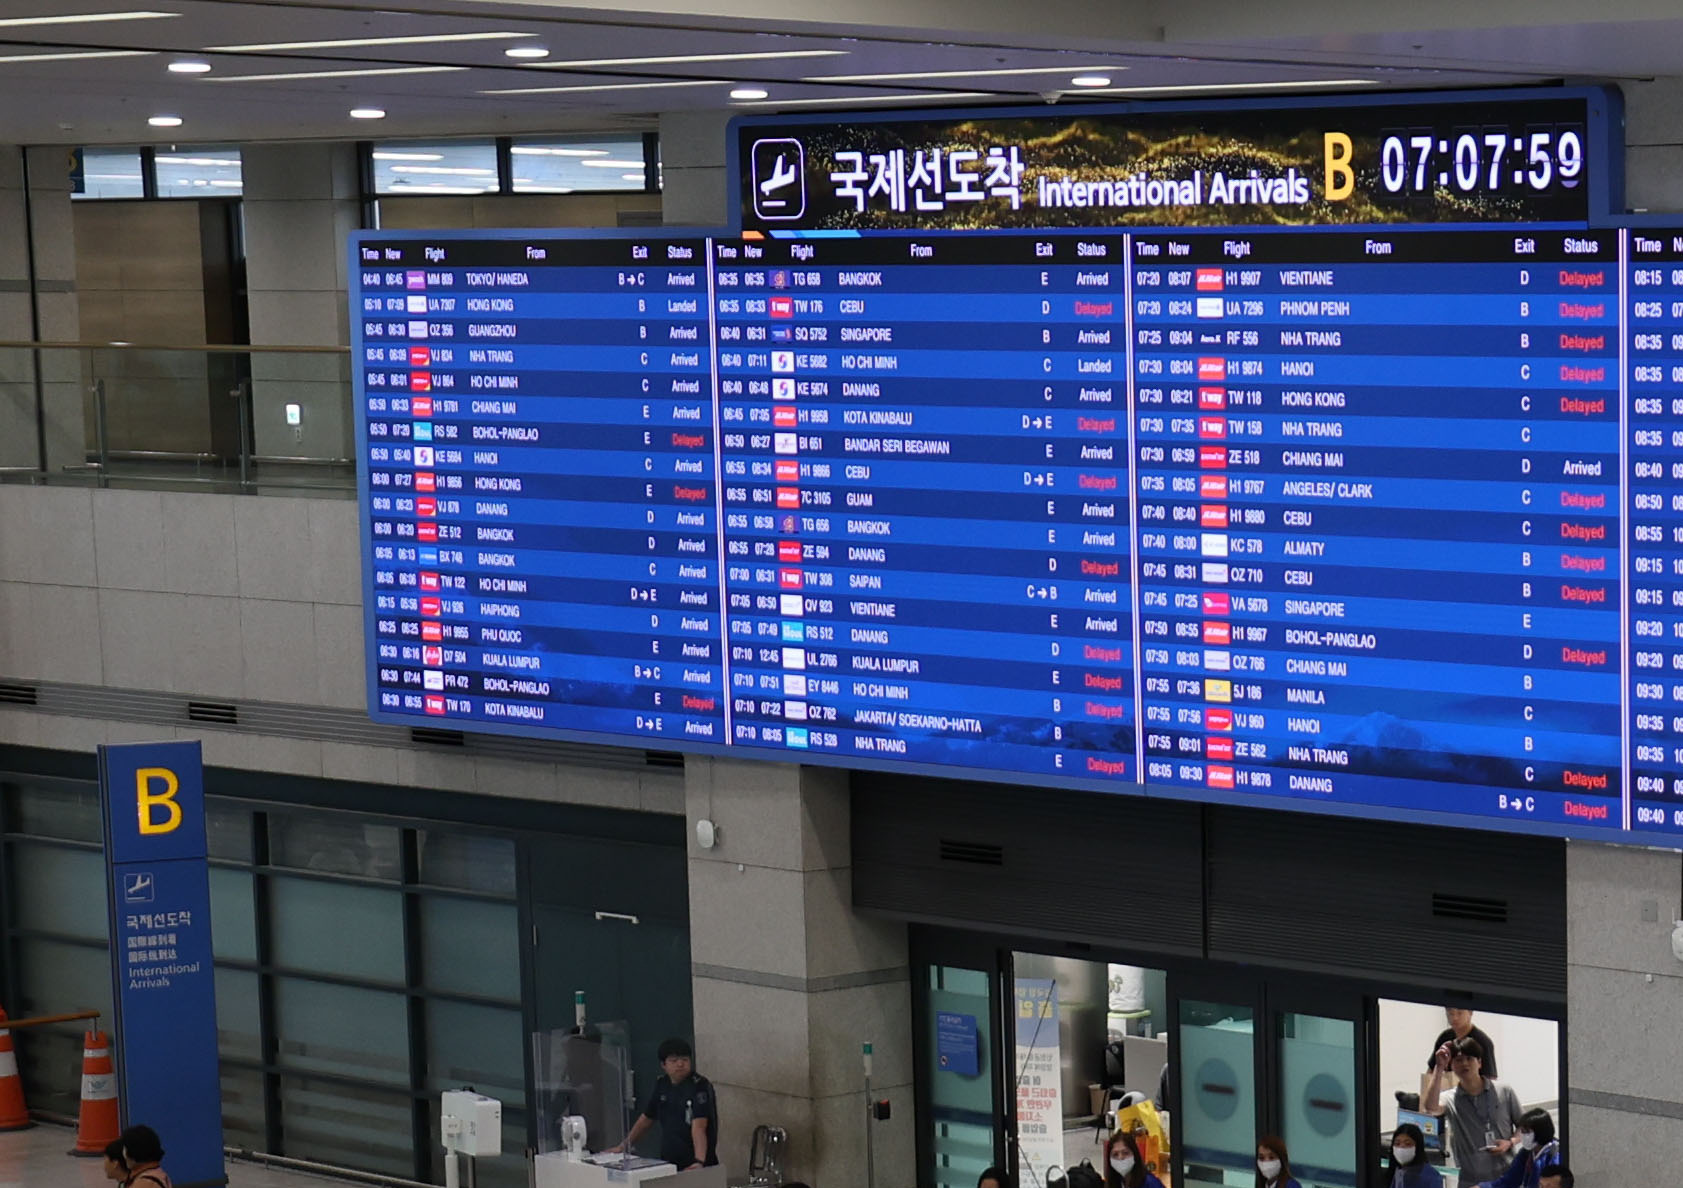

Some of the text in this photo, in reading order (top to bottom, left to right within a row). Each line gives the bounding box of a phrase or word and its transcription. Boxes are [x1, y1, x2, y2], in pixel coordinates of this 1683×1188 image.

[1324, 132, 1355, 200] B
[1383, 131, 1581, 192] 07:07:59
[830, 146, 1025, 212] 국제선도착
[1038, 168, 1309, 207] International Arrivals
[717, 242, 1106, 261] Time New Flight From Exit Status
[1136, 238, 1598, 258] Time New Flight From Exit Status
[1634, 237, 1662, 252] Time
[362, 246, 692, 262] Time New Flight From Exit Status
[466, 272, 529, 287] TOKYO/ HANEDA
[838, 272, 882, 286] BANGKOK
[1136, 270, 1604, 289] 07:20 08:07 VIENTIANE Delayed
[1634, 270, 1662, 286] 08:15
[467, 298, 697, 313] HONG KONG Landed
[1280, 301, 1350, 316] PHNOM PENH
[468, 324, 517, 338] GUANGZHOU
[840, 327, 1111, 344] SINGAPORE Arrived
[1280, 331, 1341, 347] NHA TRANG
[1634, 334, 1663, 350] 08:35
[841, 355, 1112, 373] HO CHI MINH Landed
[842, 382, 880, 397] DANANG
[1281, 391, 1605, 416] HONG KONG Delayed
[1634, 398, 1663, 414] 08:35
[843, 410, 913, 426] KOTA KINABALU
[844, 437, 950, 454] BANDAR SERI BEGAWAN
[474, 452, 498, 465] HANOI
[1282, 451, 1344, 467] CHIANG MAI
[1635, 462, 1663, 478] 08:40
[1141, 476, 1373, 499] 07:35 08:05 ANGELES/ CLARK
[1284, 541, 1325, 556] ALMATY
[1635, 557, 1663, 574] 09:15
[1285, 629, 1607, 666] BOHOL-PANGLAO Delayed
[482, 653, 540, 670] KUALA LUMPUR
[1636, 651, 1664, 669] 09:20
[483, 677, 550, 696] BOHOL-PANGLAO
[1287, 688, 1325, 705] MANILA
[854, 710, 982, 733] JAKARTA/ SOEKARNO-HATTA
[1636, 745, 1664, 762] 09:35
[1289, 775, 1333, 793] DANANG
[136, 767, 183, 835] B
[126, 911, 191, 930] 국제선도착
[129, 961, 200, 977] International
[129, 976, 170, 990] Arrivals
